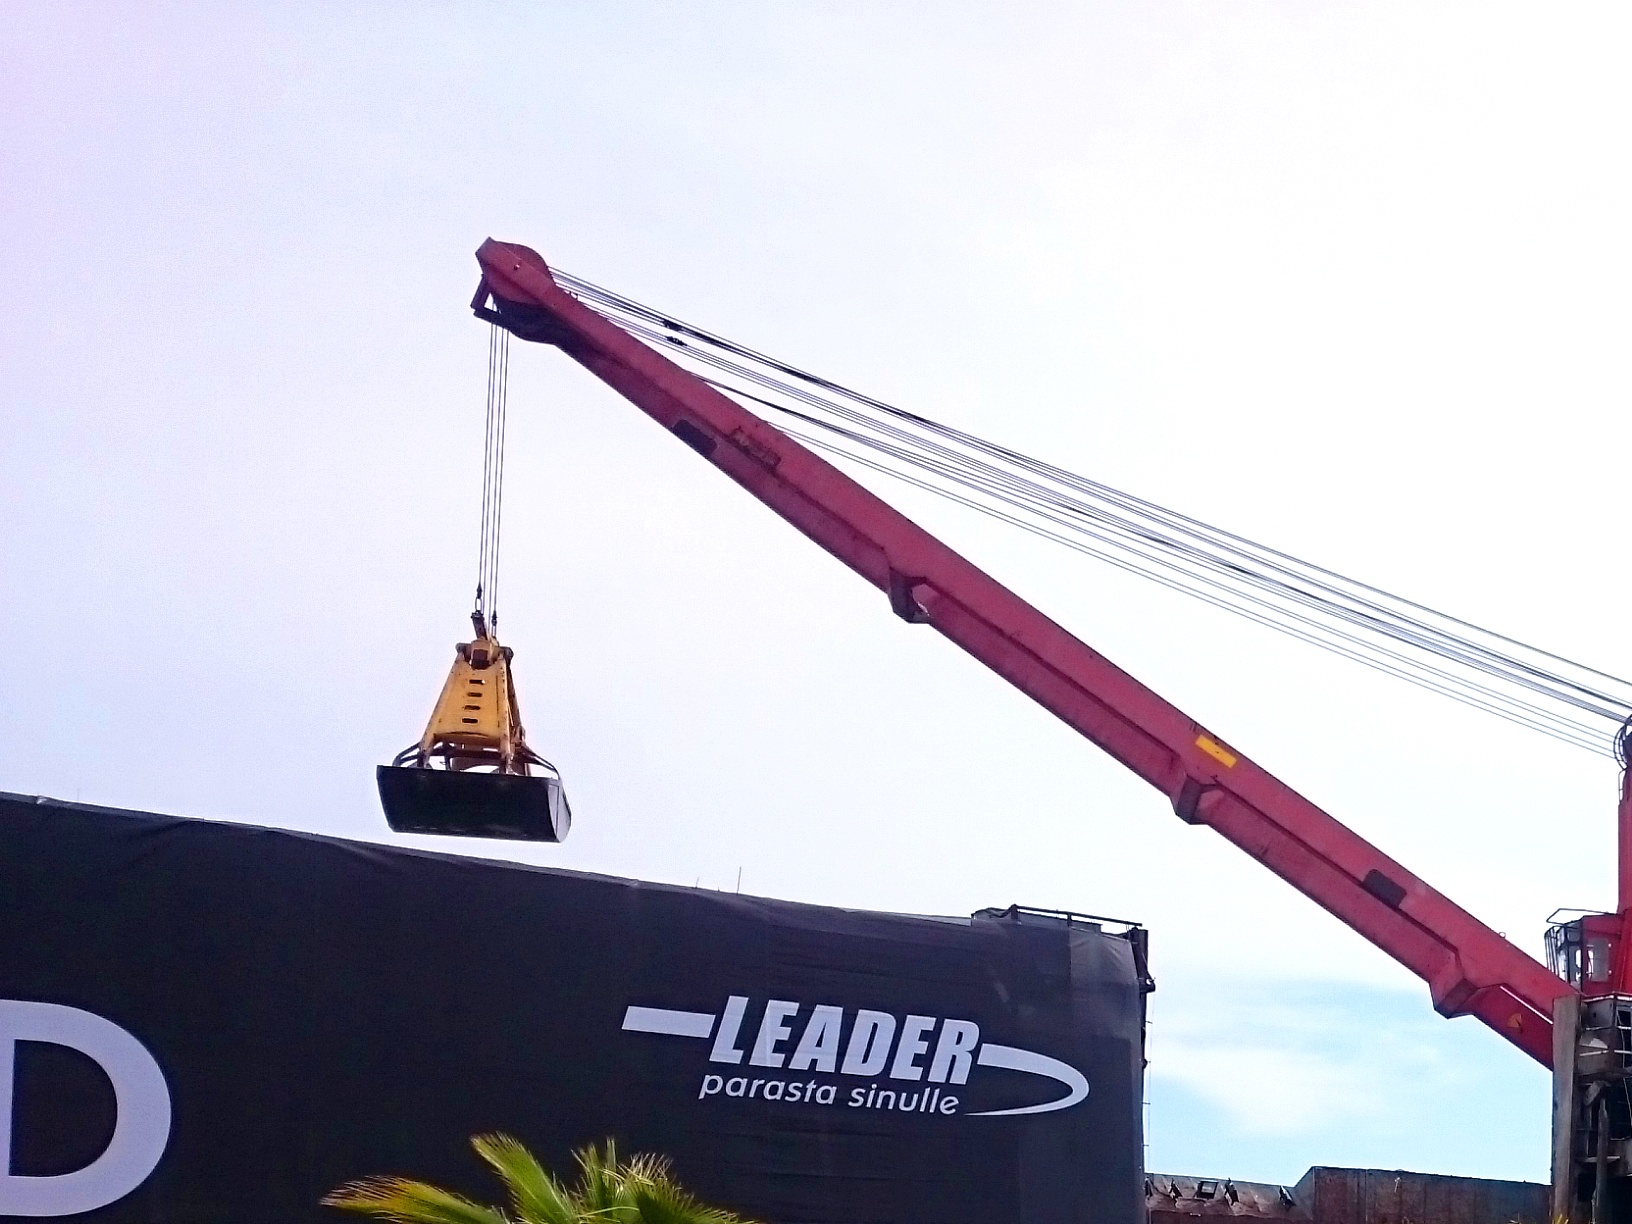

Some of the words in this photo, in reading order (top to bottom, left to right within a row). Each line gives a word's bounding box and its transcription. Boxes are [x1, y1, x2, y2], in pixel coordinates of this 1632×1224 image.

[709, 995, 980, 1085] LEADER
[698, 1073, 838, 1105] parasta
[848, 1083, 960, 1115] sinulle
